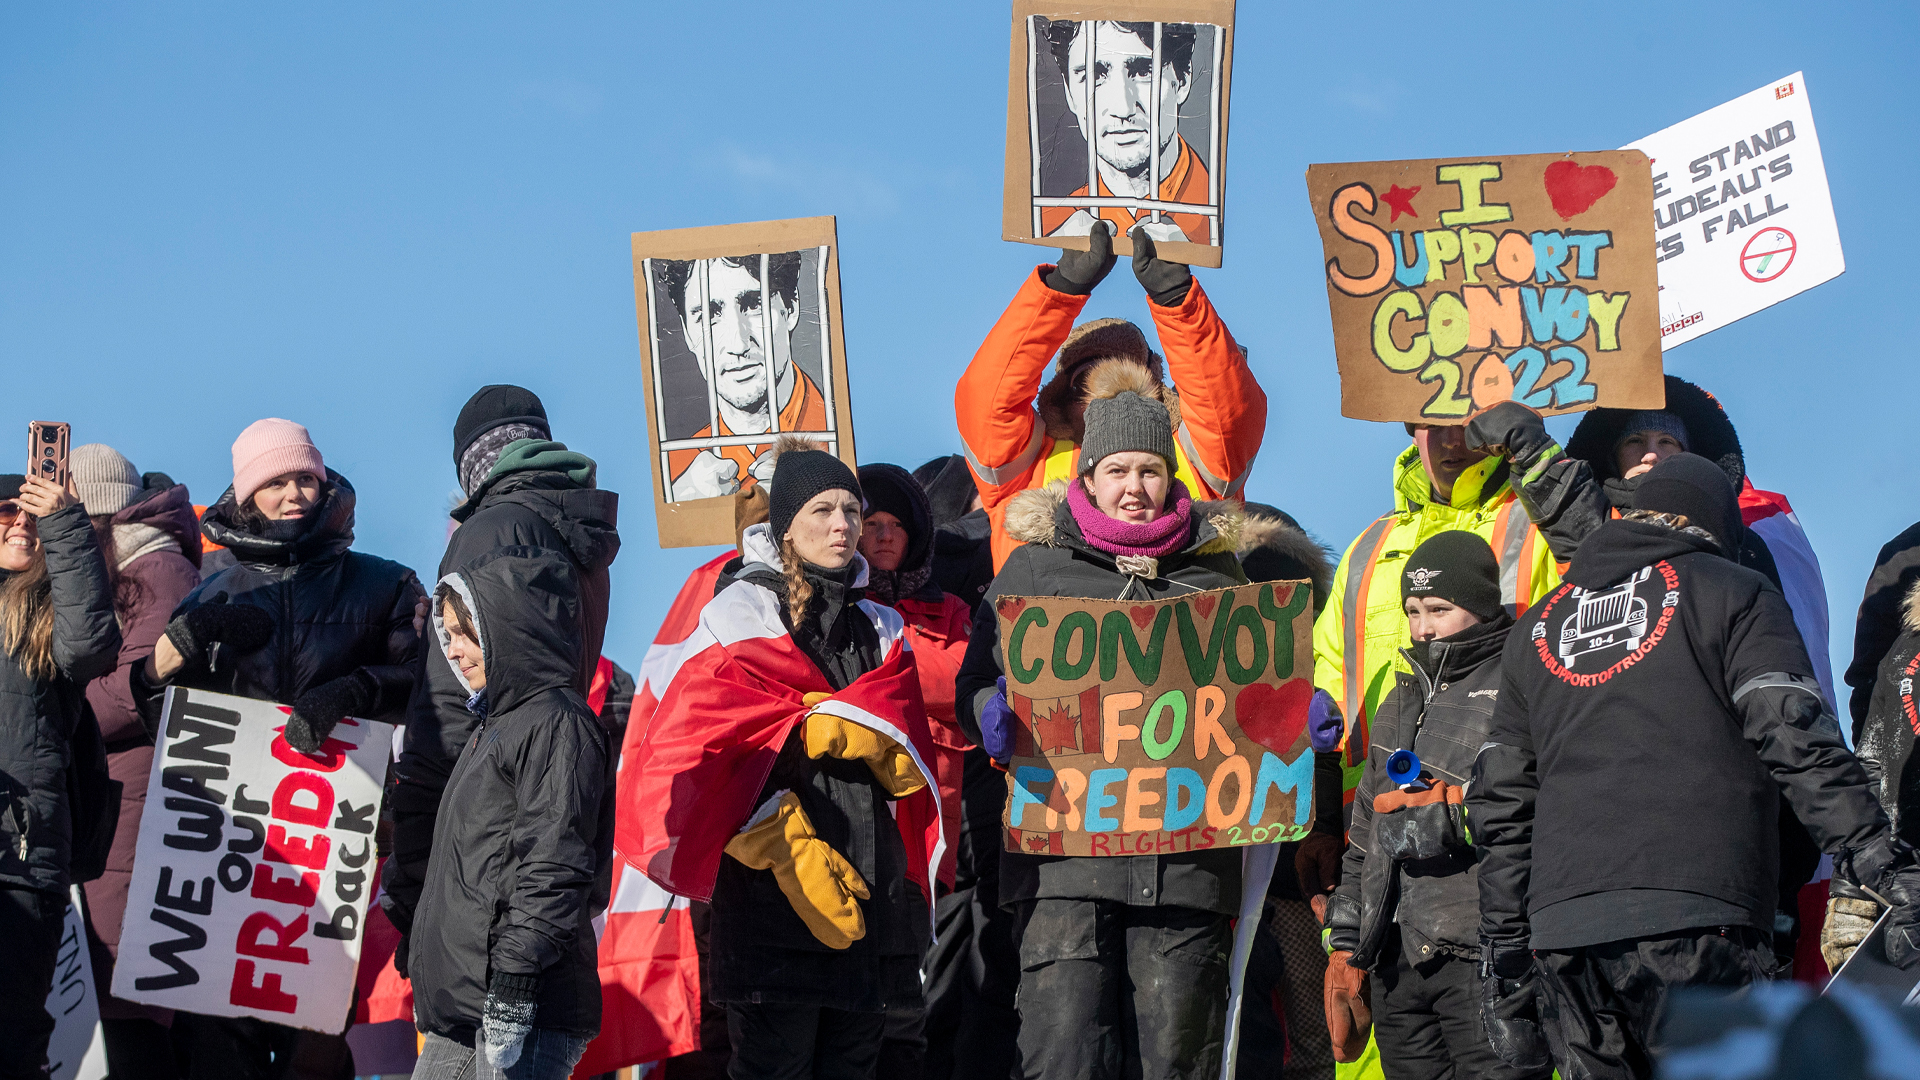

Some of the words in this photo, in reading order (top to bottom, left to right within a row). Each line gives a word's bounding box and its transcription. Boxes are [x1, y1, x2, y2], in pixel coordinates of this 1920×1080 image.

[1436, 162, 1514, 227] I
[1652, 171, 1672, 200] E
[1689, 120, 1797, 183] STAND
[1654, 154, 1793, 233] UDEAU'S
[1326, 181, 1613, 298] SUPPORT
[1702, 194, 1789, 243] FALL
[1371, 284, 1632, 374] CONVOY
[1417, 344, 1598, 418] 2022
[1008, 583, 1312, 687] CONVOY
[1589, 634, 1614, 649] 10-4
[1102, 685, 1237, 764] FOR
[162, 687, 242, 852] WANT
[1010, 746, 1316, 833] FREEDOM
[229, 705, 359, 1015] FREEDO
[313, 799, 377, 941] back
[1091, 826, 1219, 857] RIGHTS
[1227, 822, 1311, 847] 2022
[135, 866, 216, 992] WE
